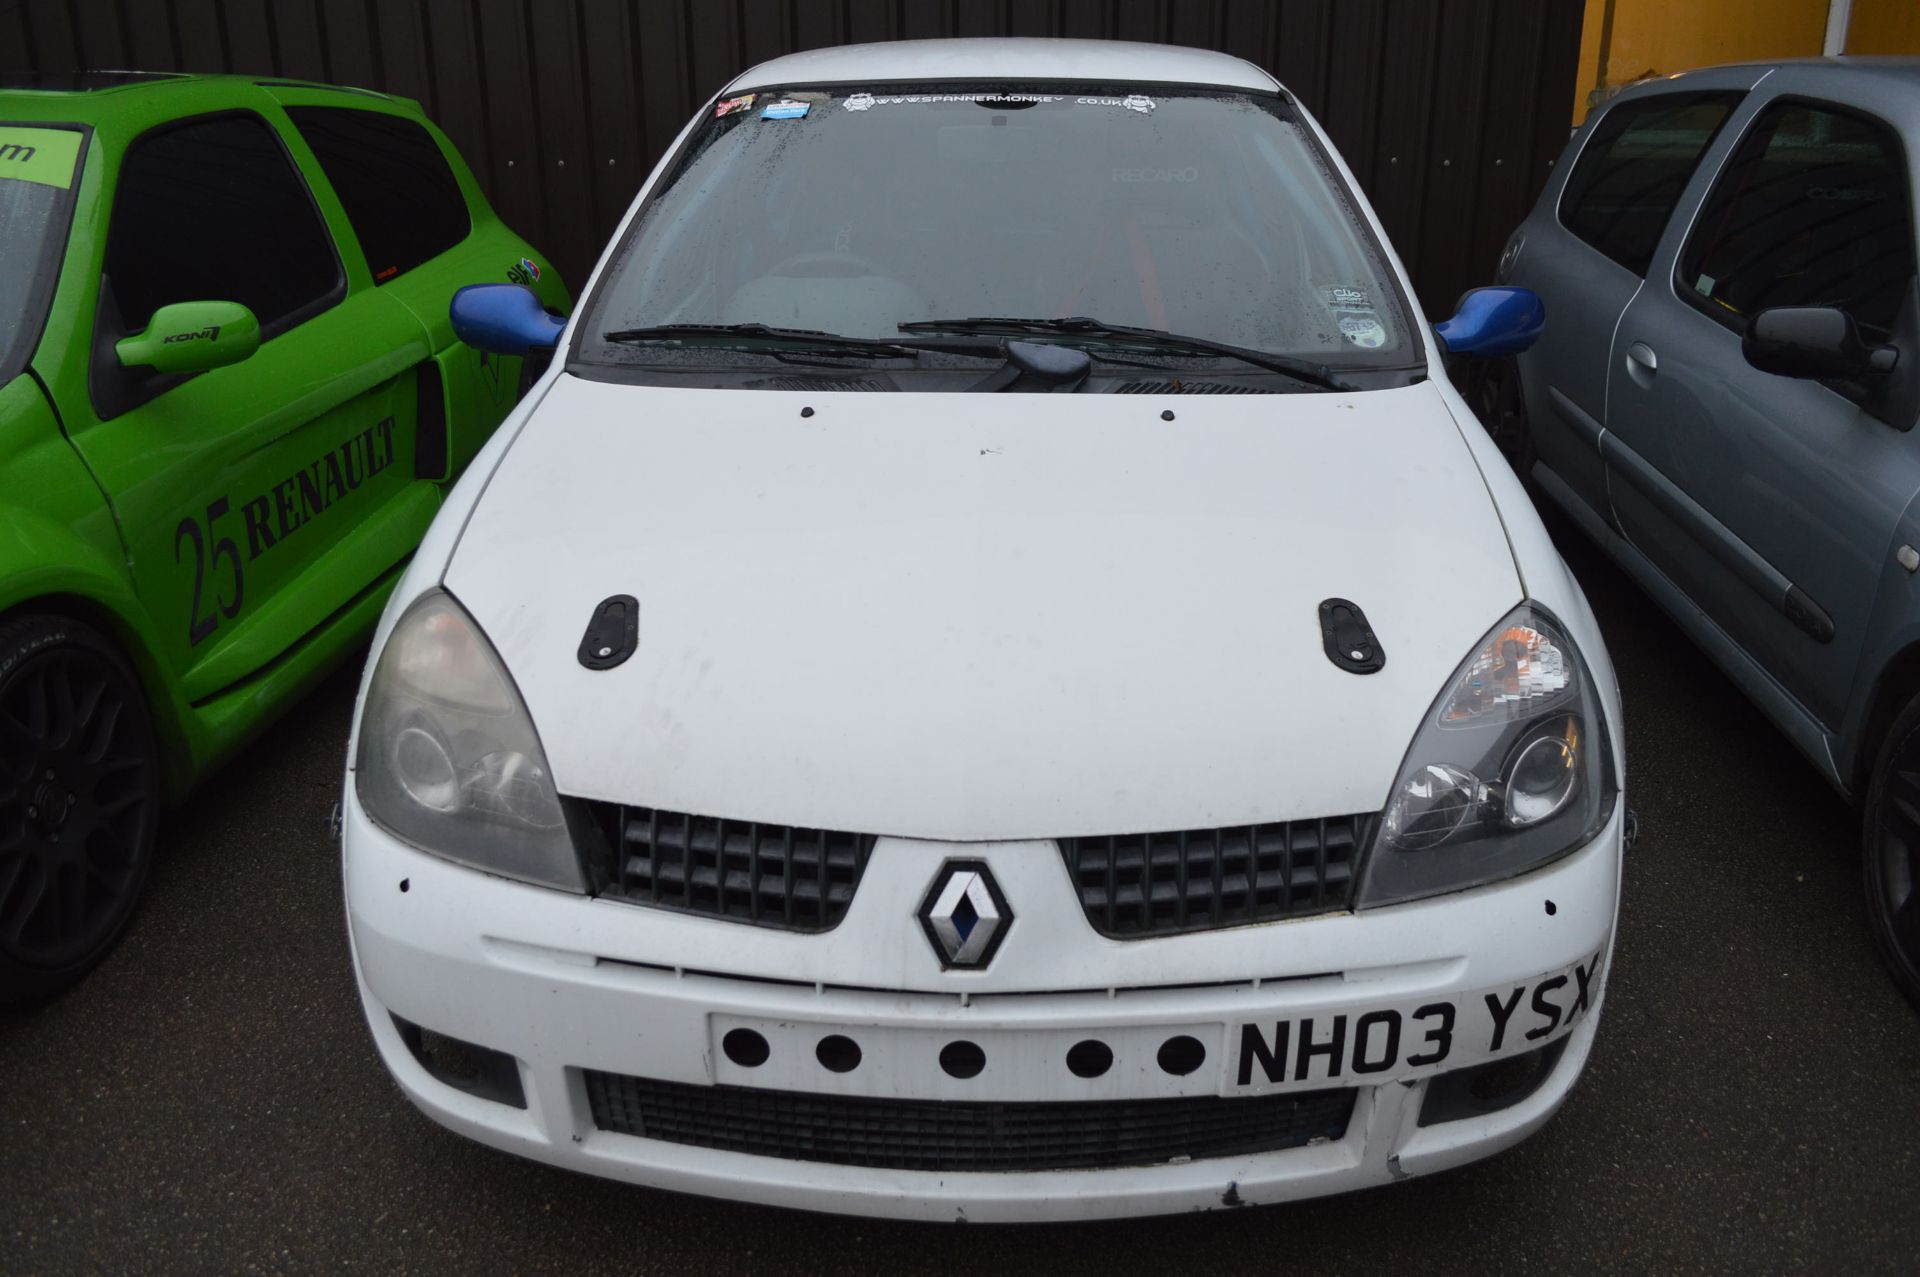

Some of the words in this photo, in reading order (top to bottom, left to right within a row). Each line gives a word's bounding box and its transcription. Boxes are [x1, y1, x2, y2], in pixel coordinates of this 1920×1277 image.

[1111, 167, 1199, 182] RECARO
[175, 495, 244, 648] 25
[241, 415, 396, 562] RENAULT
[1237, 1001, 1457, 1085] NH03
[1484, 951, 1600, 1052] YSX
